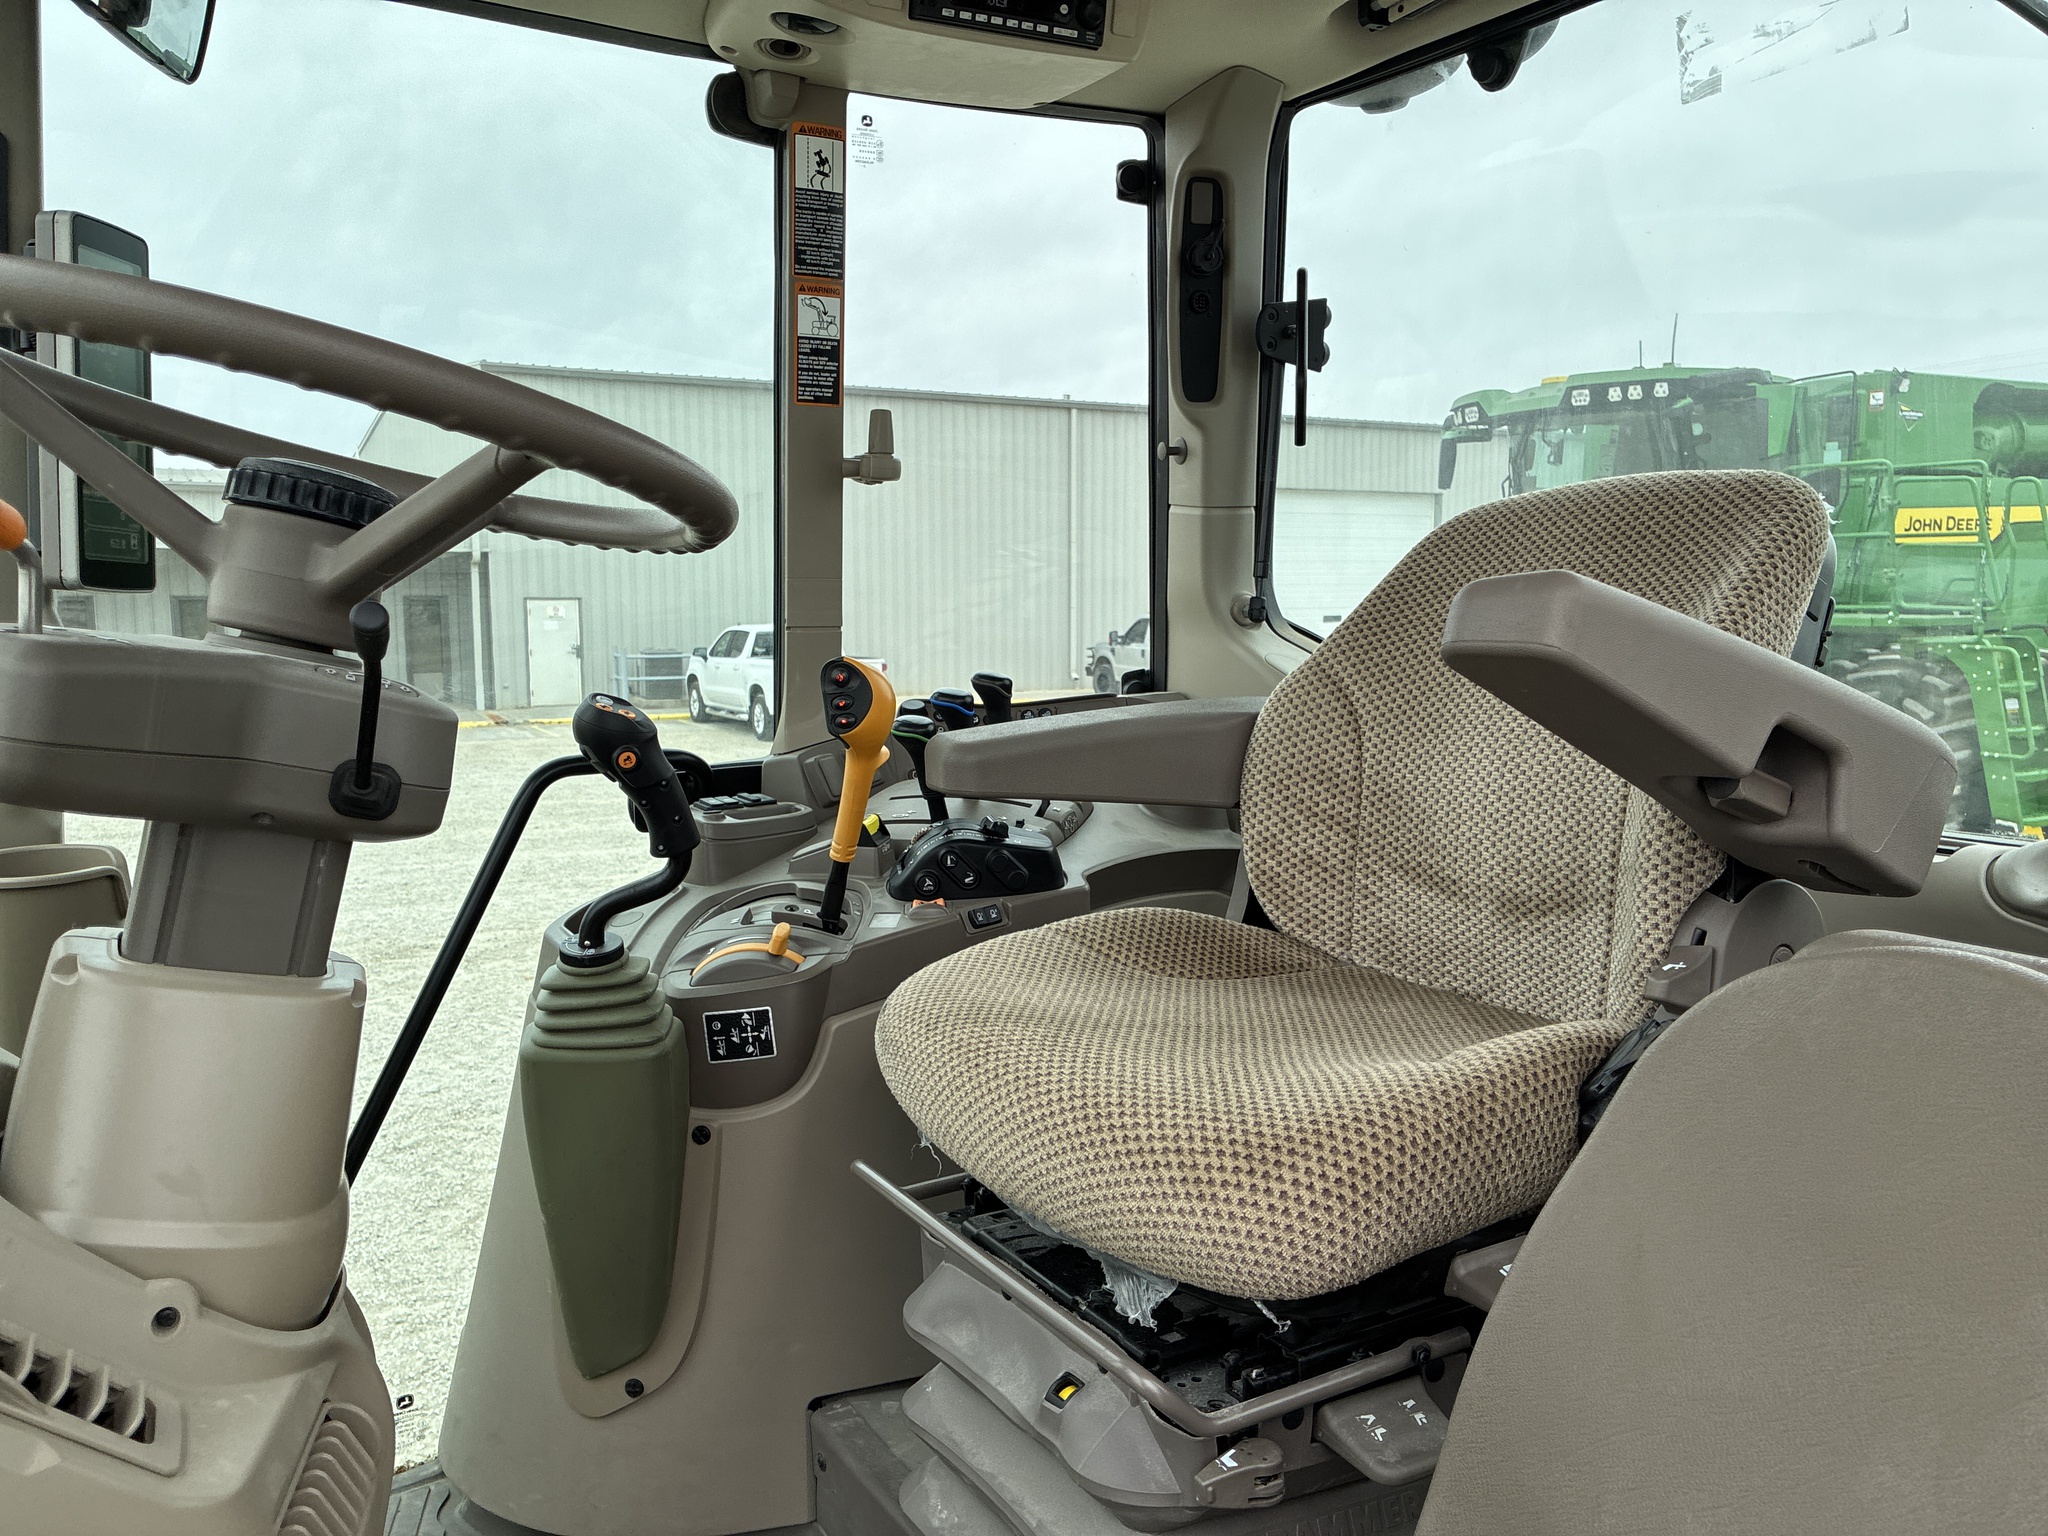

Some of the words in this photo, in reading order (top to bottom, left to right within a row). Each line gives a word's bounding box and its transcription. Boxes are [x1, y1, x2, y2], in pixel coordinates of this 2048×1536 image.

[807, 125, 842, 139] WARNING
[807, 286, 841, 296] WARNING
[1904, 516, 1943, 532] JOHN
